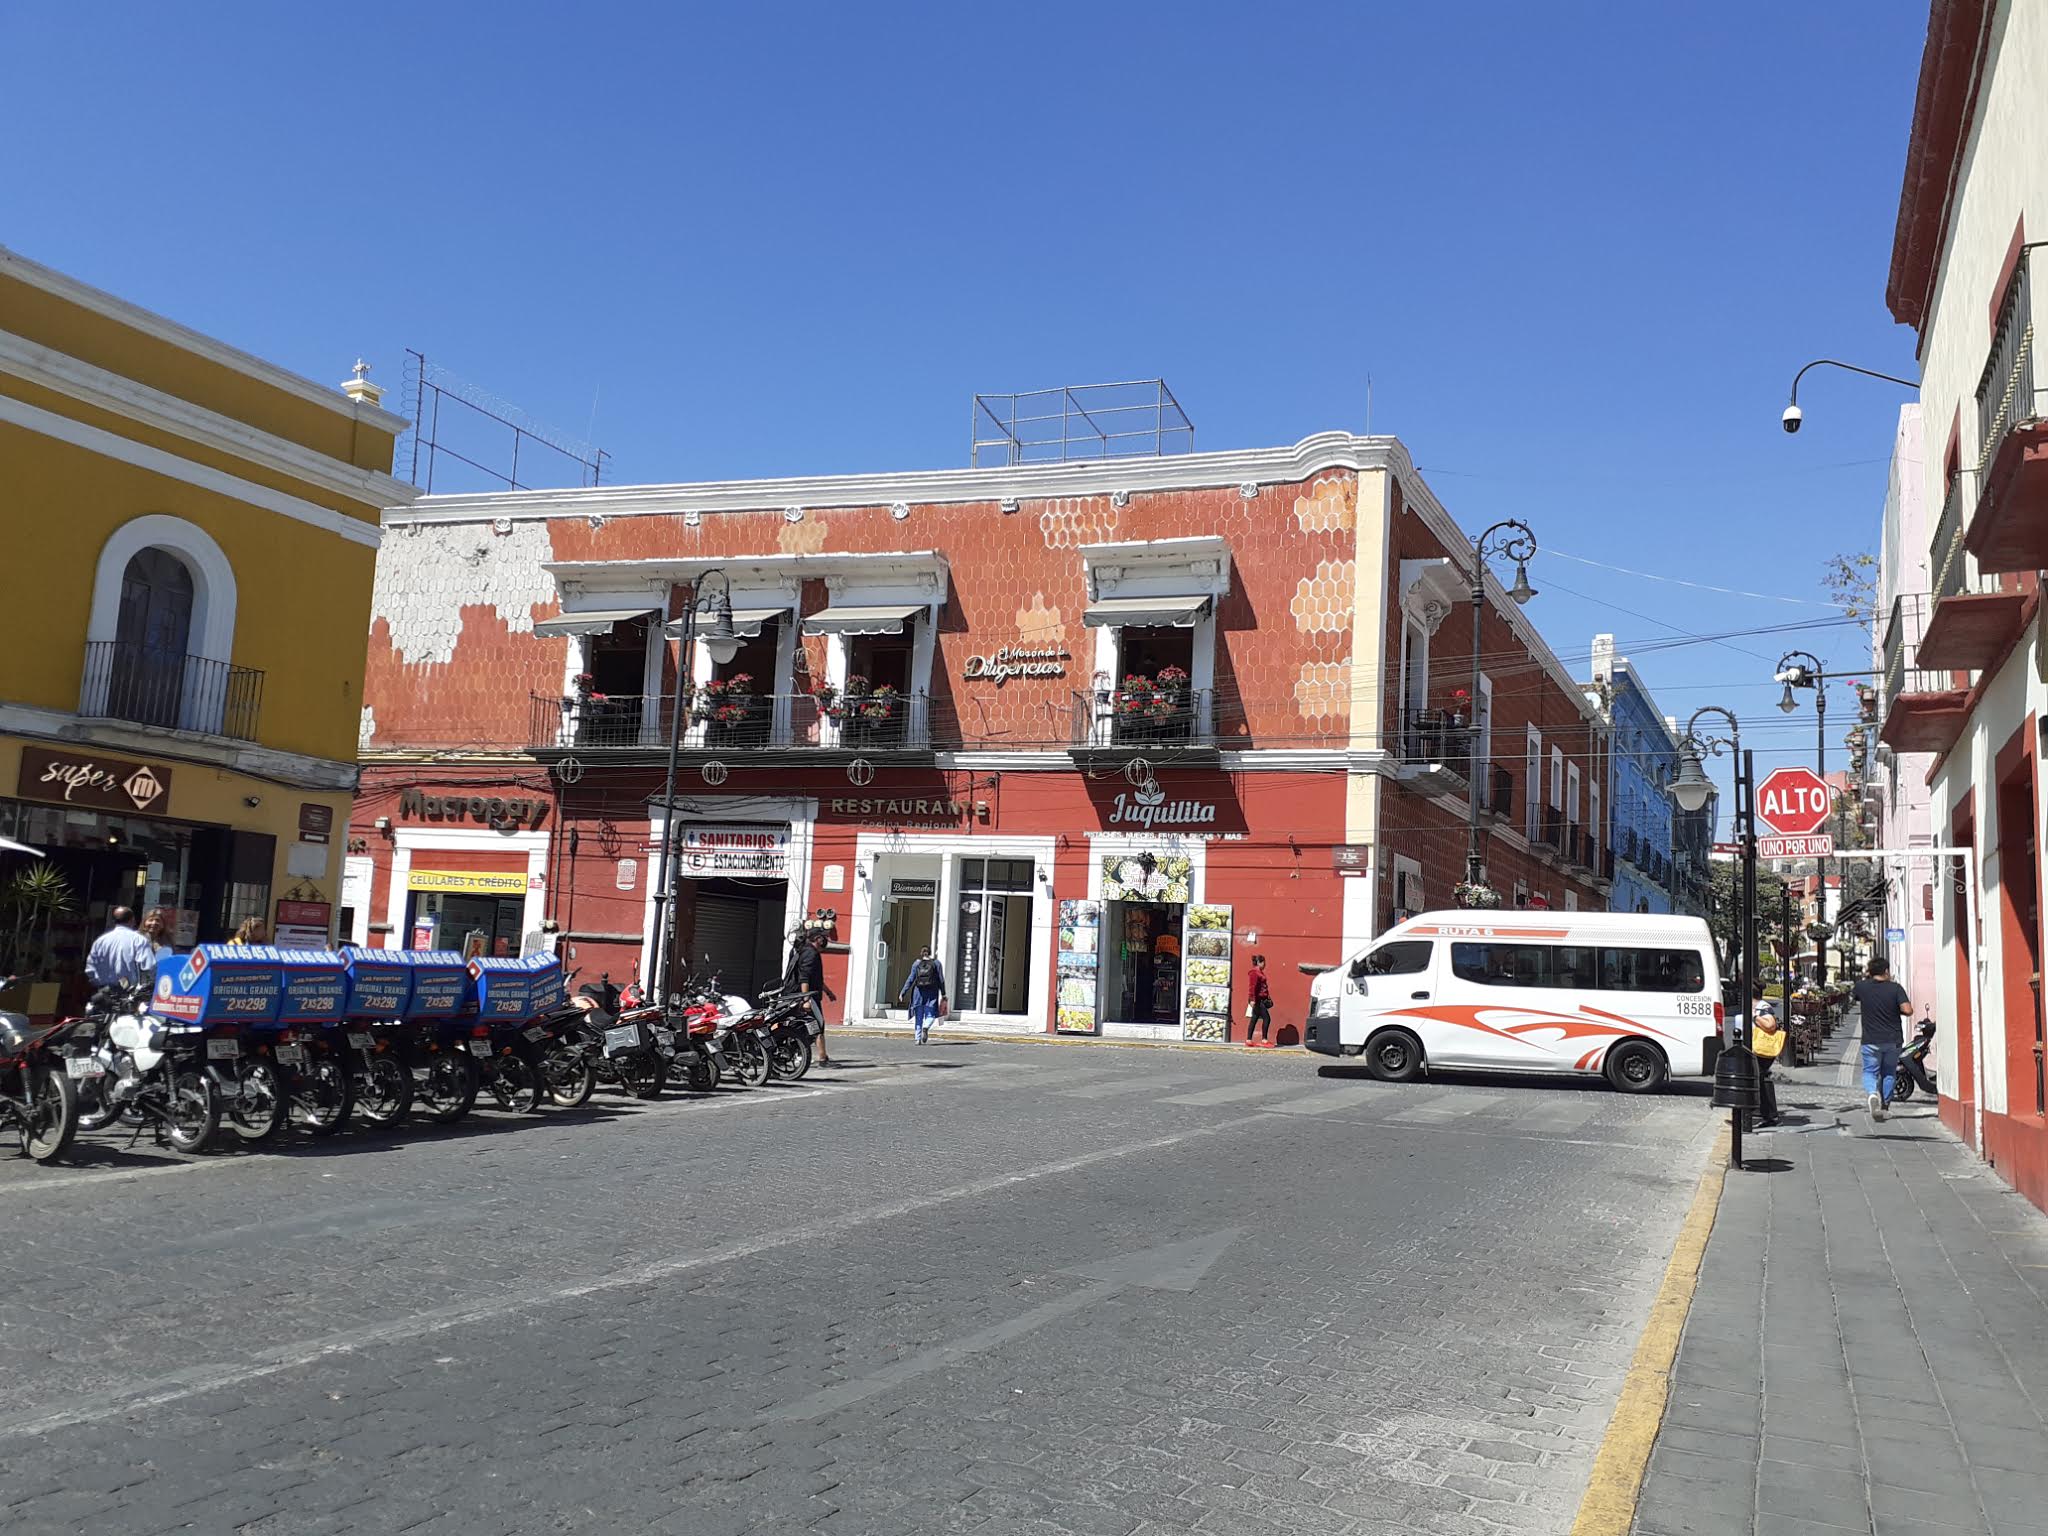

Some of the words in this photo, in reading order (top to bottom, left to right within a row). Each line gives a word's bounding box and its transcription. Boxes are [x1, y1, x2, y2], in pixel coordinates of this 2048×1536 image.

[964, 655, 1063, 684] Diligencias
[40, 762, 118, 800] super
[400, 788, 547, 823] Macropay
[832, 798, 986, 816] RESTAURANTE
[1764, 787, 1825, 815] ALTO
[1109, 793, 1216, 829] Juquilita
[699, 832, 775, 849] SANITARIOS
[1763, 841, 1784, 855] UNO
[1786, 840, 1807, 854] POR
[1808, 838, 1829, 853] UNO
[693, 855, 701, 867] E
[714, 853, 785, 870] ESTACIONAMIENTO
[410, 875, 465, 887] CELULARES
[468, 876, 475, 887] A
[477, 875, 522, 888] CRÉDITO
[892, 883, 934, 893] Bienvenidos
[1437, 927, 1481, 937] RUTA
[1484, 928, 1494, 937] 6
[207, 946, 222, 959] 24
[222, 946, 237, 960] 44
[237, 946, 251, 960] 45
[251, 947, 266, 960] 45
[265, 946, 281, 960] 10
[213, 985, 247, 995] ORIGINAL
[249, 986, 279, 995] GRANDE
[288, 986, 317, 995] ORIGINAL
[318, 986, 343, 995] GRANDE
[355, 983, 383, 994] ORIGINAL
[384, 986, 408, 995] GRANDE
[1346, 983, 1365, 995] U-5
[1676, 994, 1712, 1003] CONCESION
[1676, 1002, 1712, 1016] 18588
